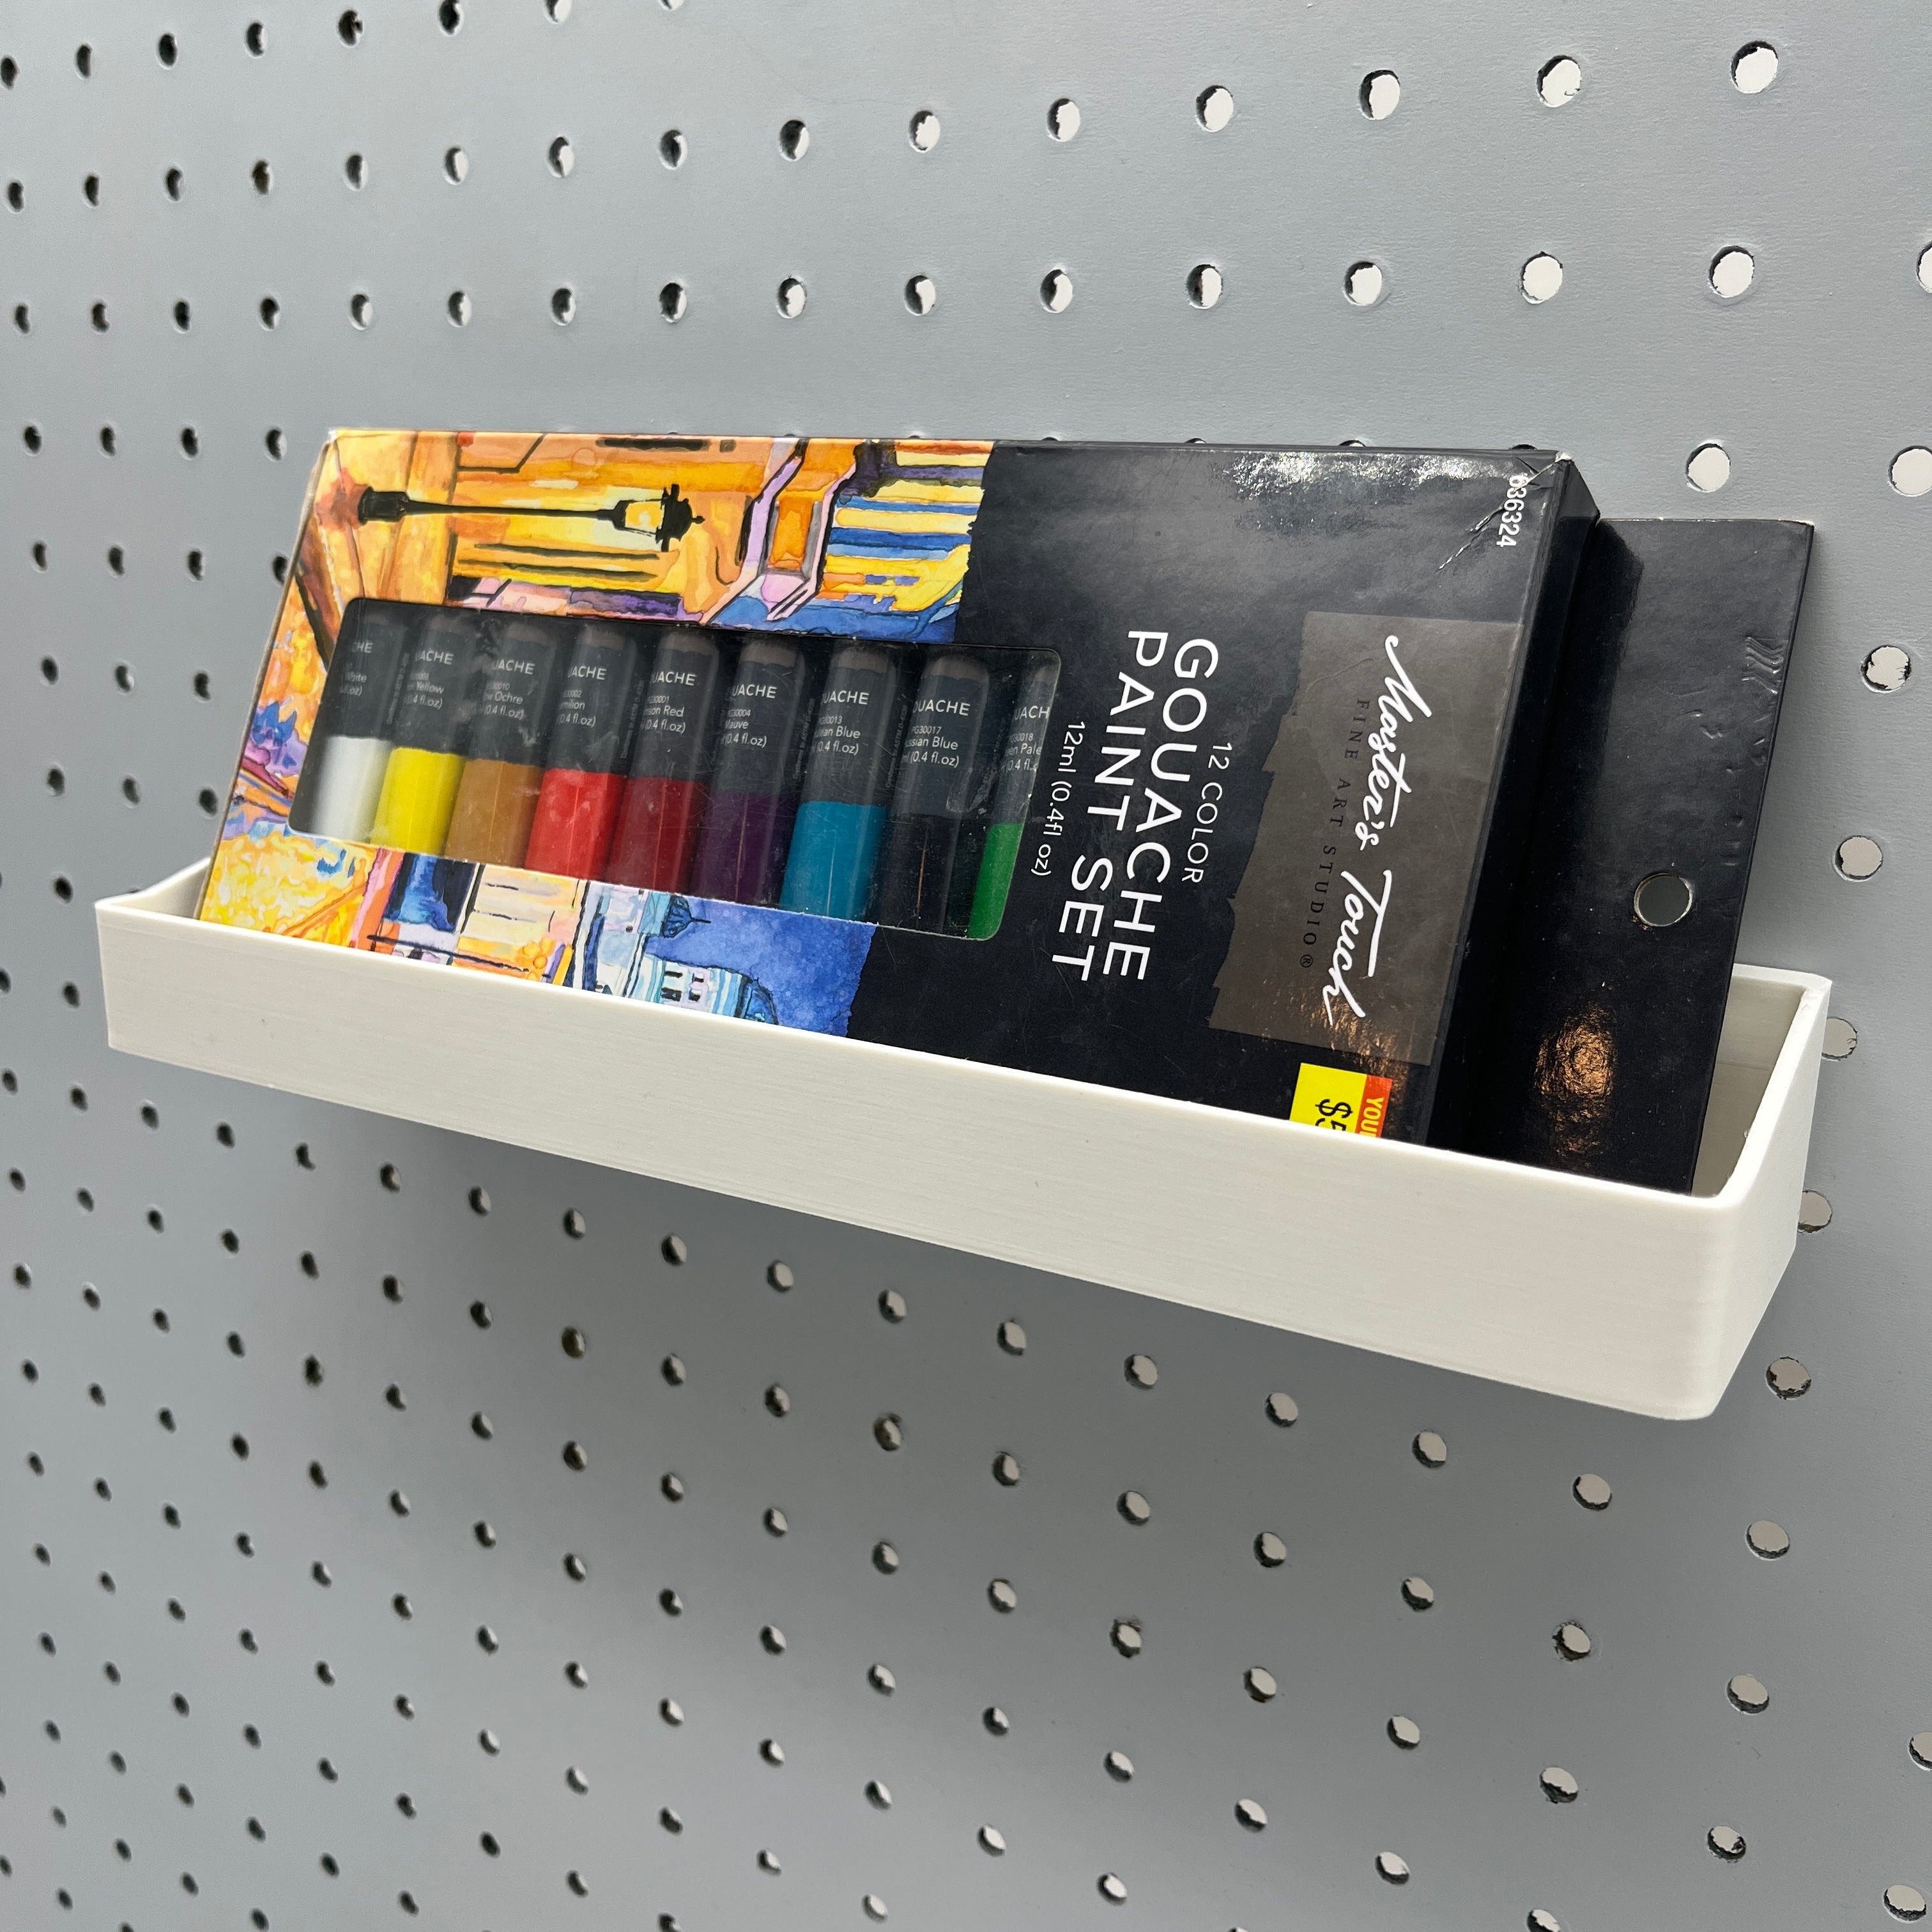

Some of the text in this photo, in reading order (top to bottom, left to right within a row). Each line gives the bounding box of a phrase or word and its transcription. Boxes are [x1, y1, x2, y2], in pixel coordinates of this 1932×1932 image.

[417, 681, 445, 694] Yellow
[494, 691, 523, 705] Ochre
[663, 705, 685, 717] Red
[661, 719, 686, 734] fl.oz)
[836, 726, 861, 739] Blue
[1344, 698, 1371, 760] FINE
[741, 733, 767, 748] fl.oz)
[832, 740, 859, 756] fl.oz)
[932, 736, 958, 750] Blue
[1020, 742, 1043, 755] Pale
[910, 751, 928, 764] (0.4
[931, 751, 960, 768] fl.oz)
[1031, 721, 1085, 877] 12ml (0.4fl oz)
[1052, 631, 1169, 981] PAINT SET
[1329, 778, 1351, 827] ART
[1102, 638, 1219, 980] GOUACHE
[1181, 742, 1232, 883] 12 COLOR
[1322, 635, 1432, 1026] Master's Touch
[1360, 1097, 1384, 1137] YOU
